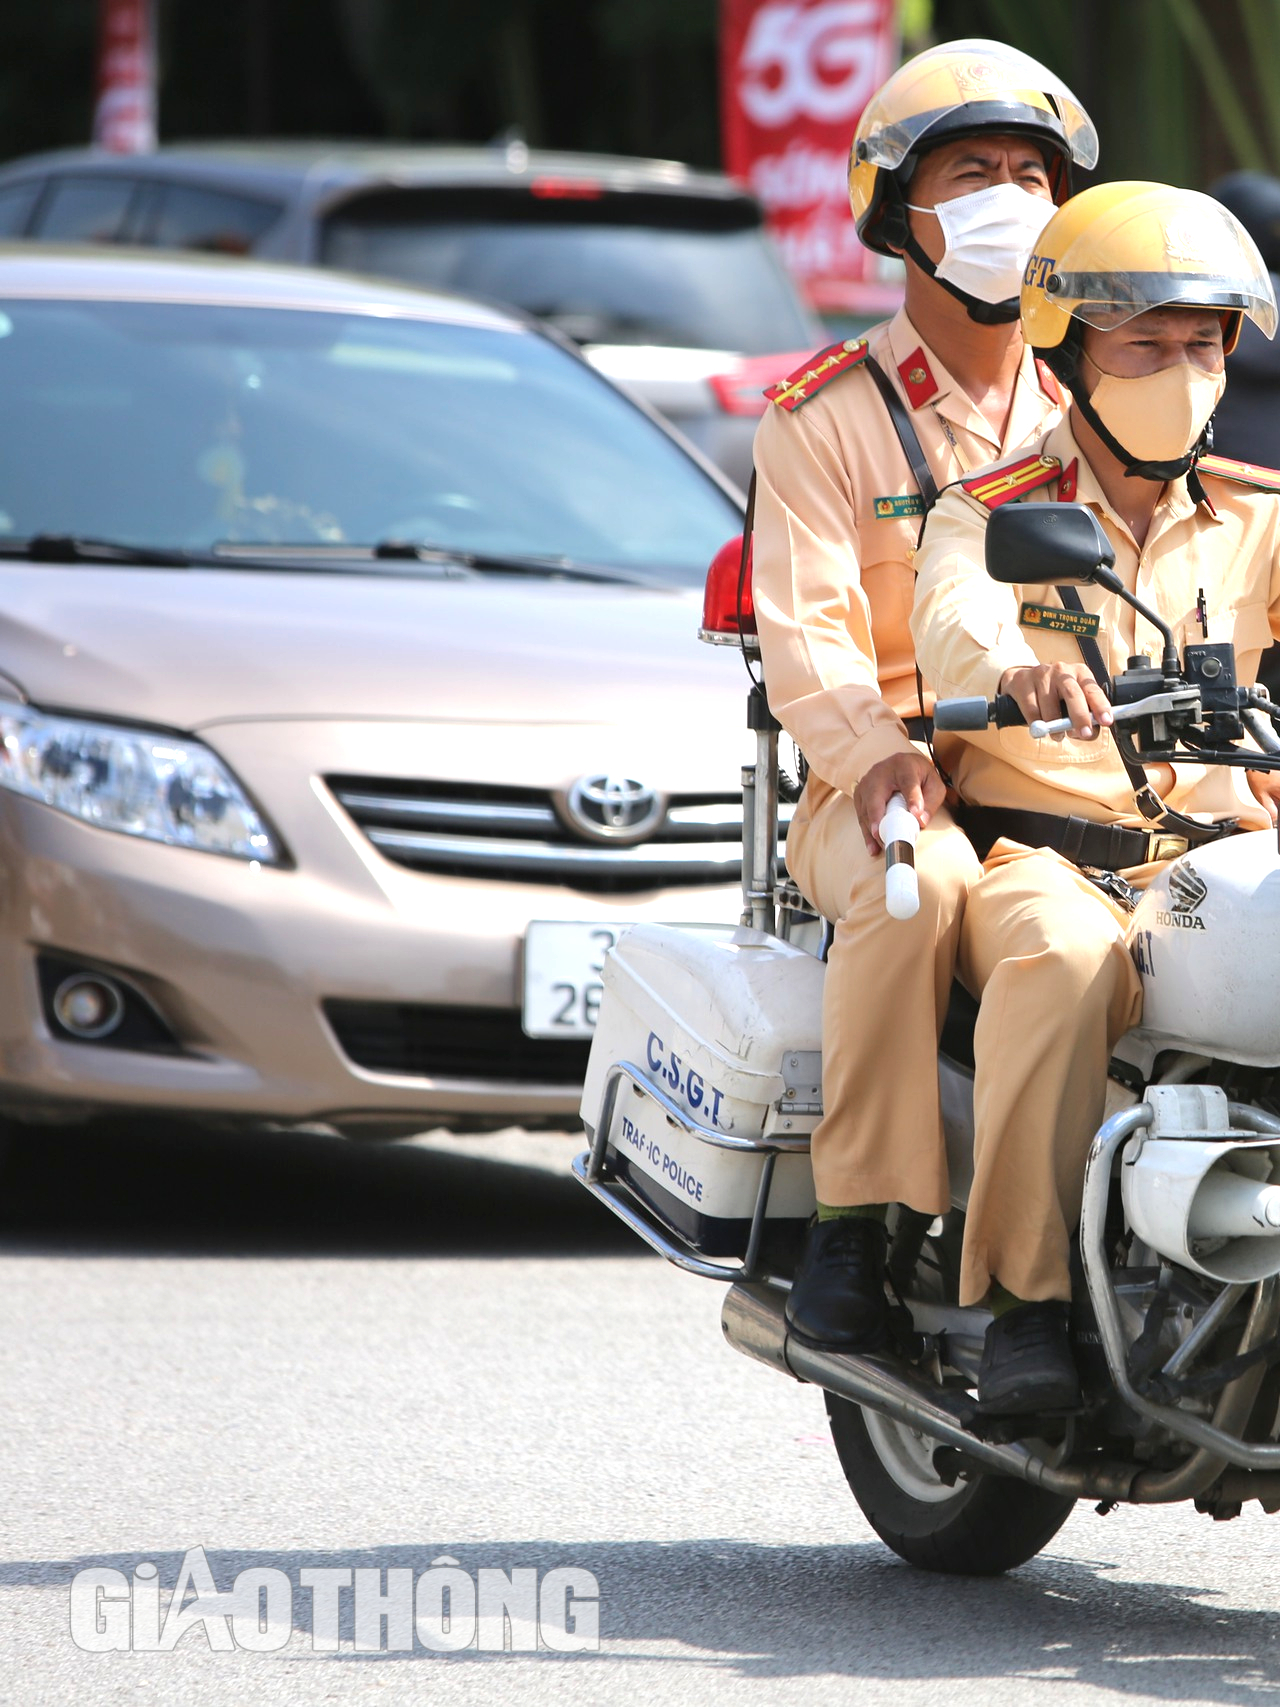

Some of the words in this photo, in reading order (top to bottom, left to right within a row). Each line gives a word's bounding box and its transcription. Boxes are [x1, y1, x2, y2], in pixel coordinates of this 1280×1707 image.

[738, 0, 877, 129] 5G
[1049, 621, 1065, 629] 477
[1072, 624, 1087, 633] 127
[1156, 911, 1207, 931] HONDA
[622, 1116, 661, 1167] TRAFIC
[662, 1153, 703, 1203] POLICE
